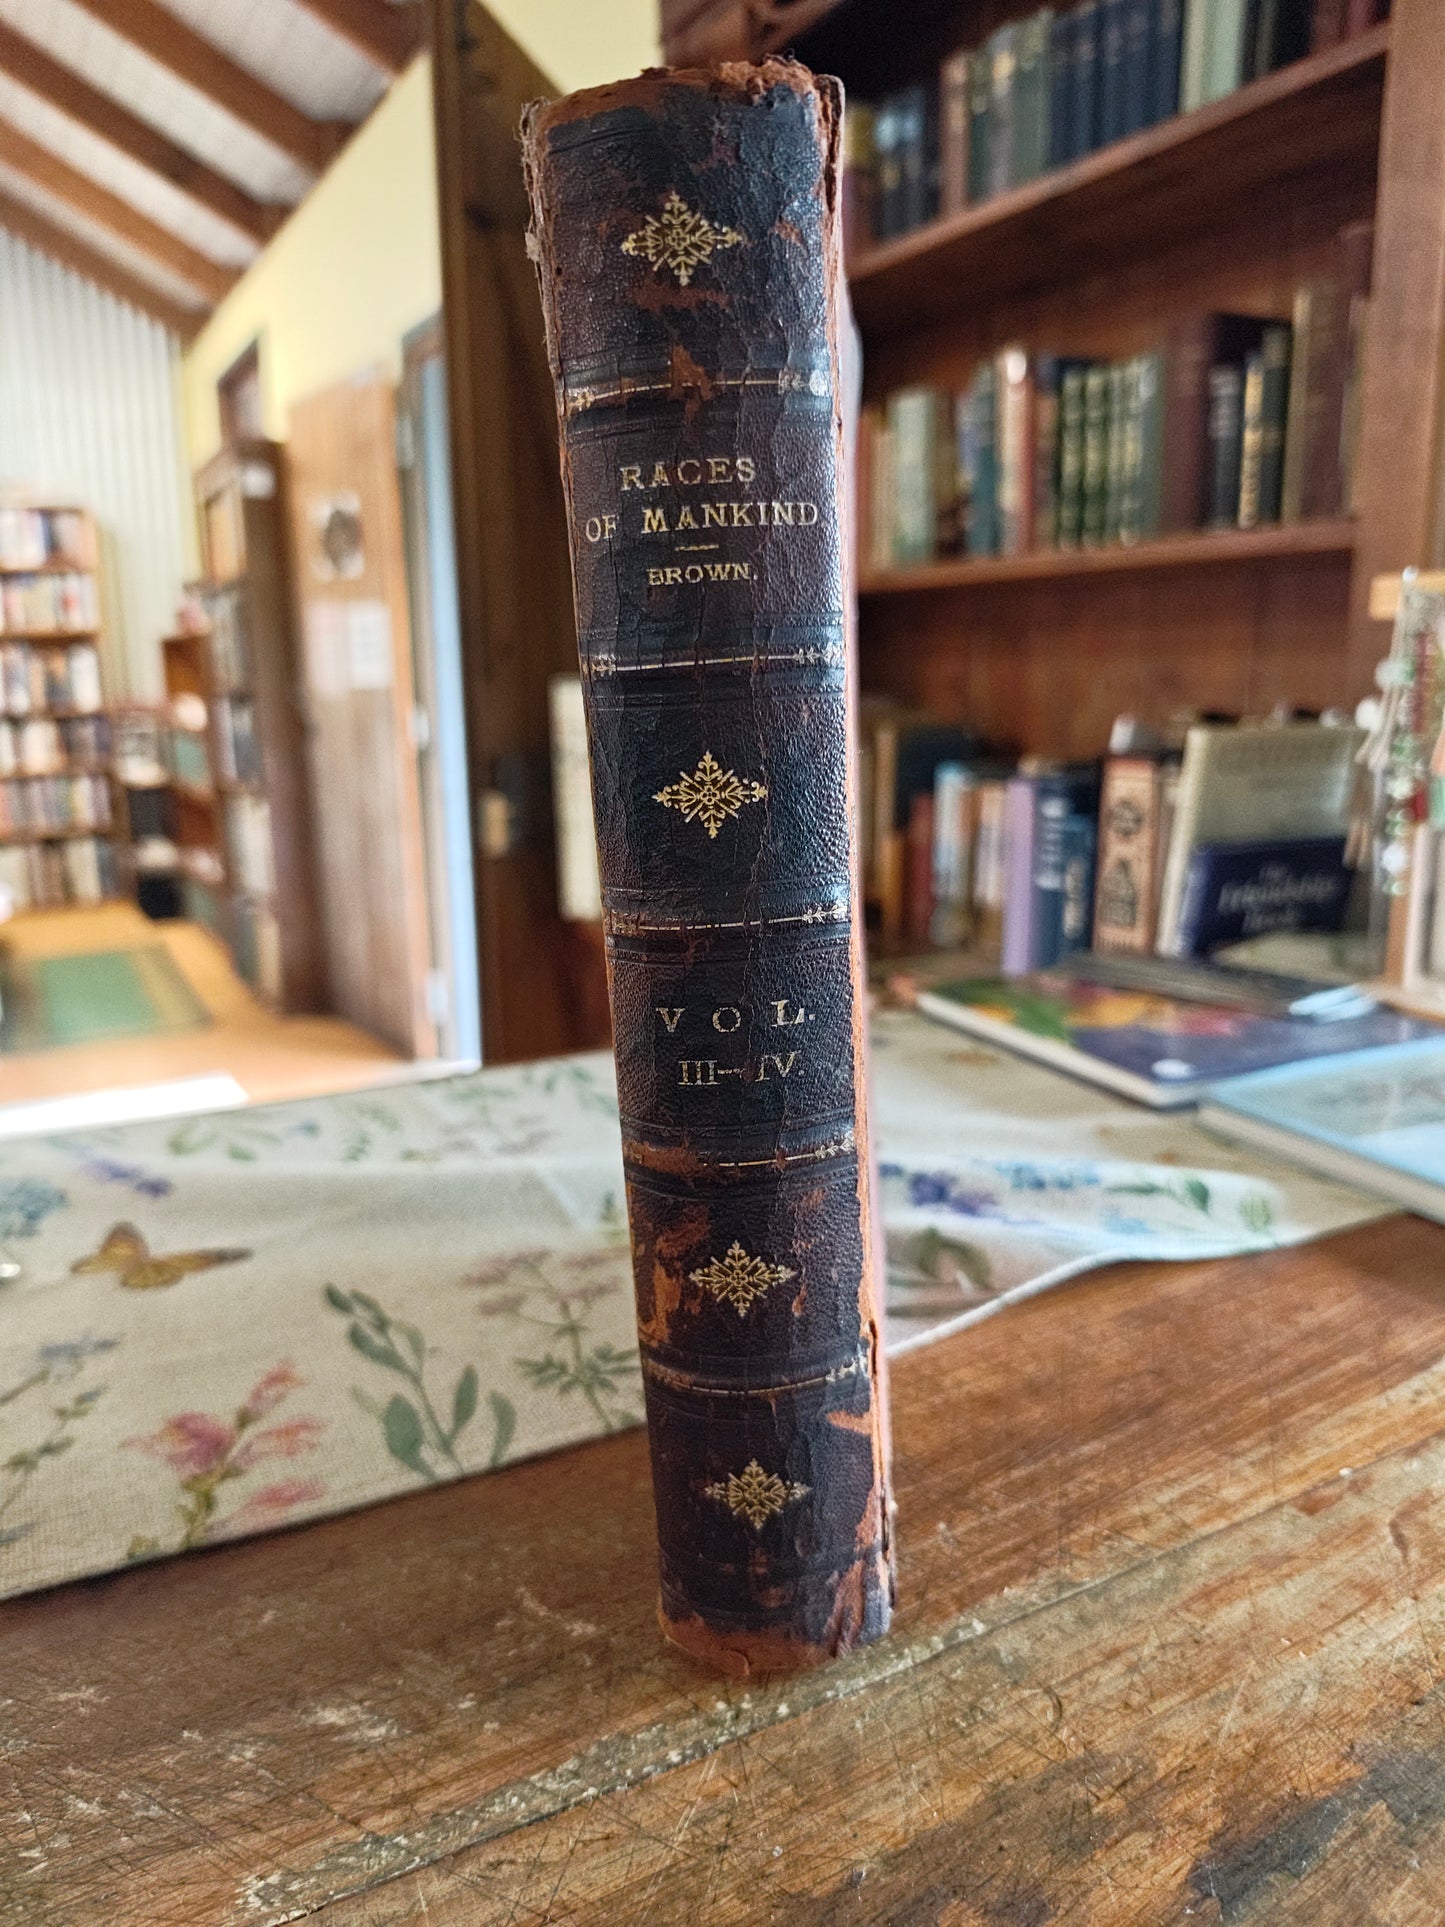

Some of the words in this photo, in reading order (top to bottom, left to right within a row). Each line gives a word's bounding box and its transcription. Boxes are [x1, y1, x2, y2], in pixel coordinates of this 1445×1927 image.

[619, 457, 757, 491] RACES
[585, 513, 619, 542] OF
[641, 501, 819, 534] MANKIND
